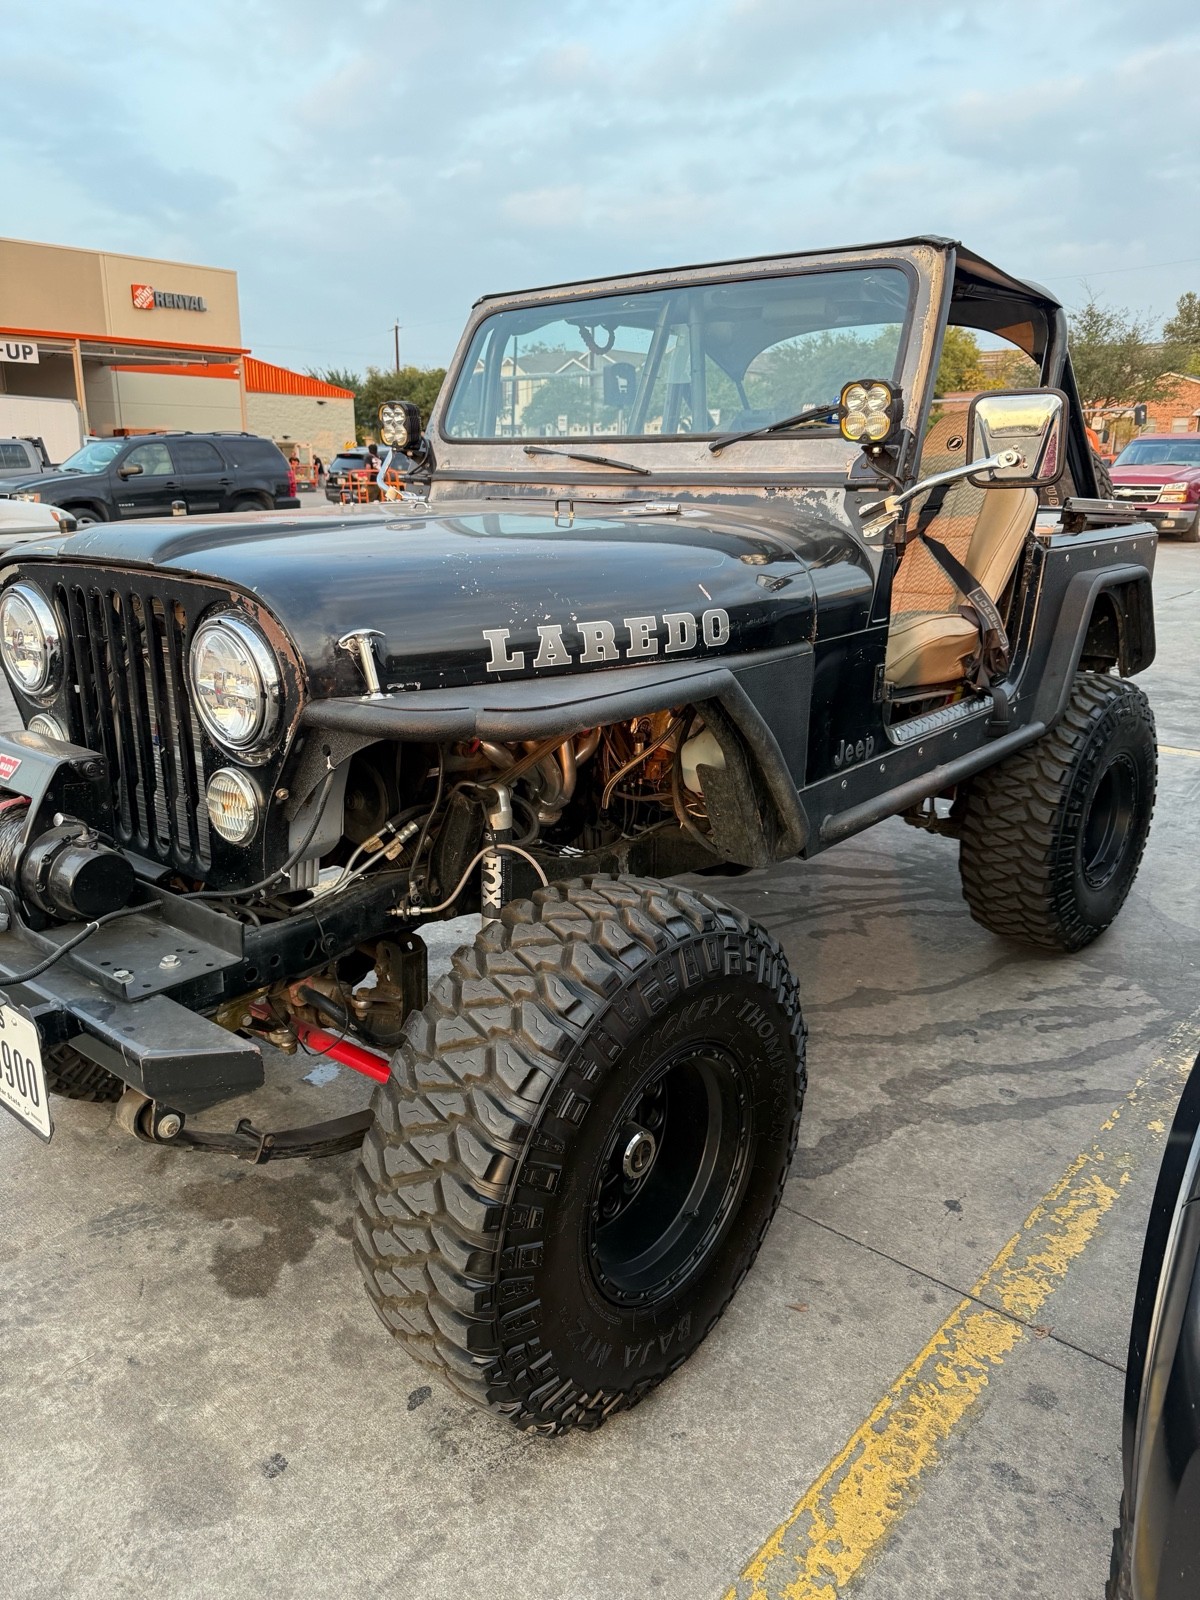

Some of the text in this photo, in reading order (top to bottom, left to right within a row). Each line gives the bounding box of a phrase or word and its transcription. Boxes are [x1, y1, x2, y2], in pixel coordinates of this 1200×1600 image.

[154, 291, 207, 312] RENTAL
[482, 608, 730, 673] LAREDO
[834, 735, 875, 766] Jeep
[482, 855, 503, 909] FOX
[0, 1040, 40, 1107] 900
[624, 1311, 692, 1368] BAJA
